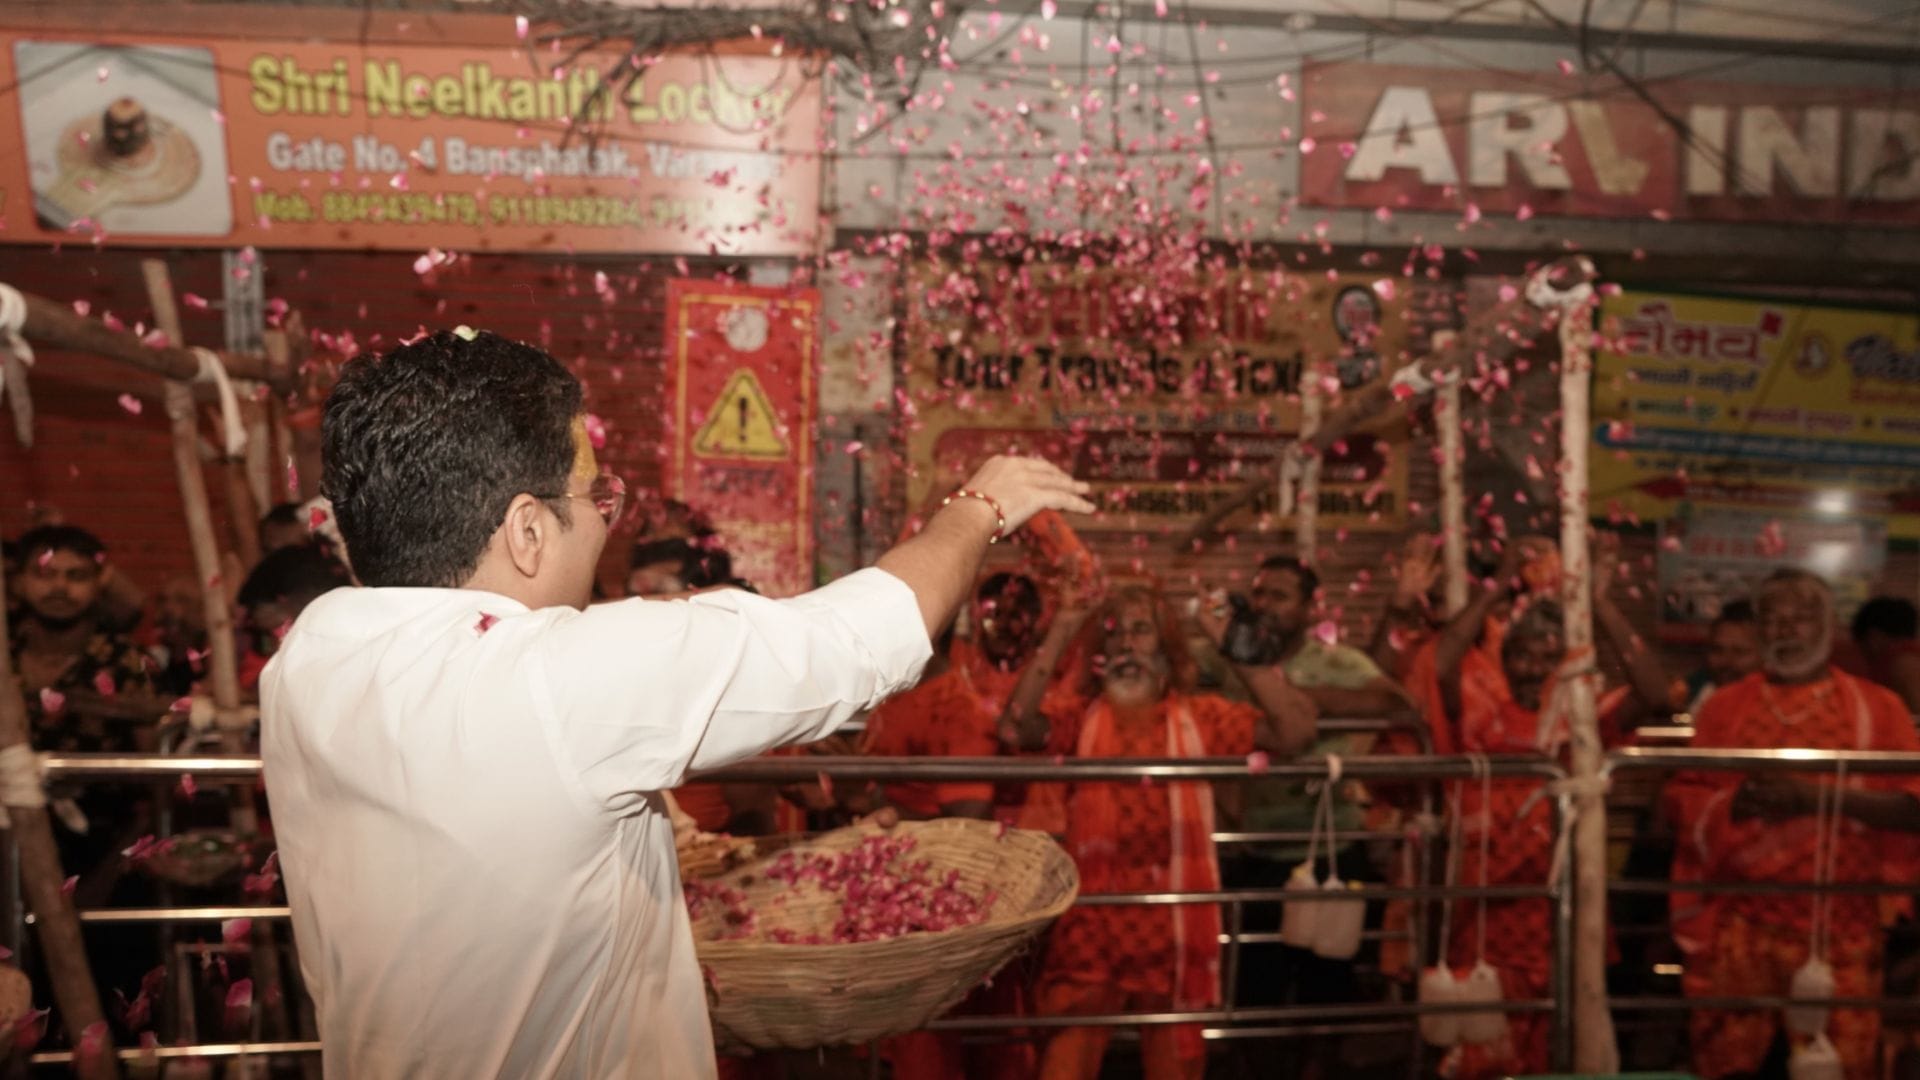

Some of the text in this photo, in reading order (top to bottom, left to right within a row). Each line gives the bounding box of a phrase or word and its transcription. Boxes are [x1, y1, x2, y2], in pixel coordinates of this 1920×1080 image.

[250, 56, 349, 114] Shri
[267, 133, 346, 172] Gate
[353, 136, 408, 172] No.
